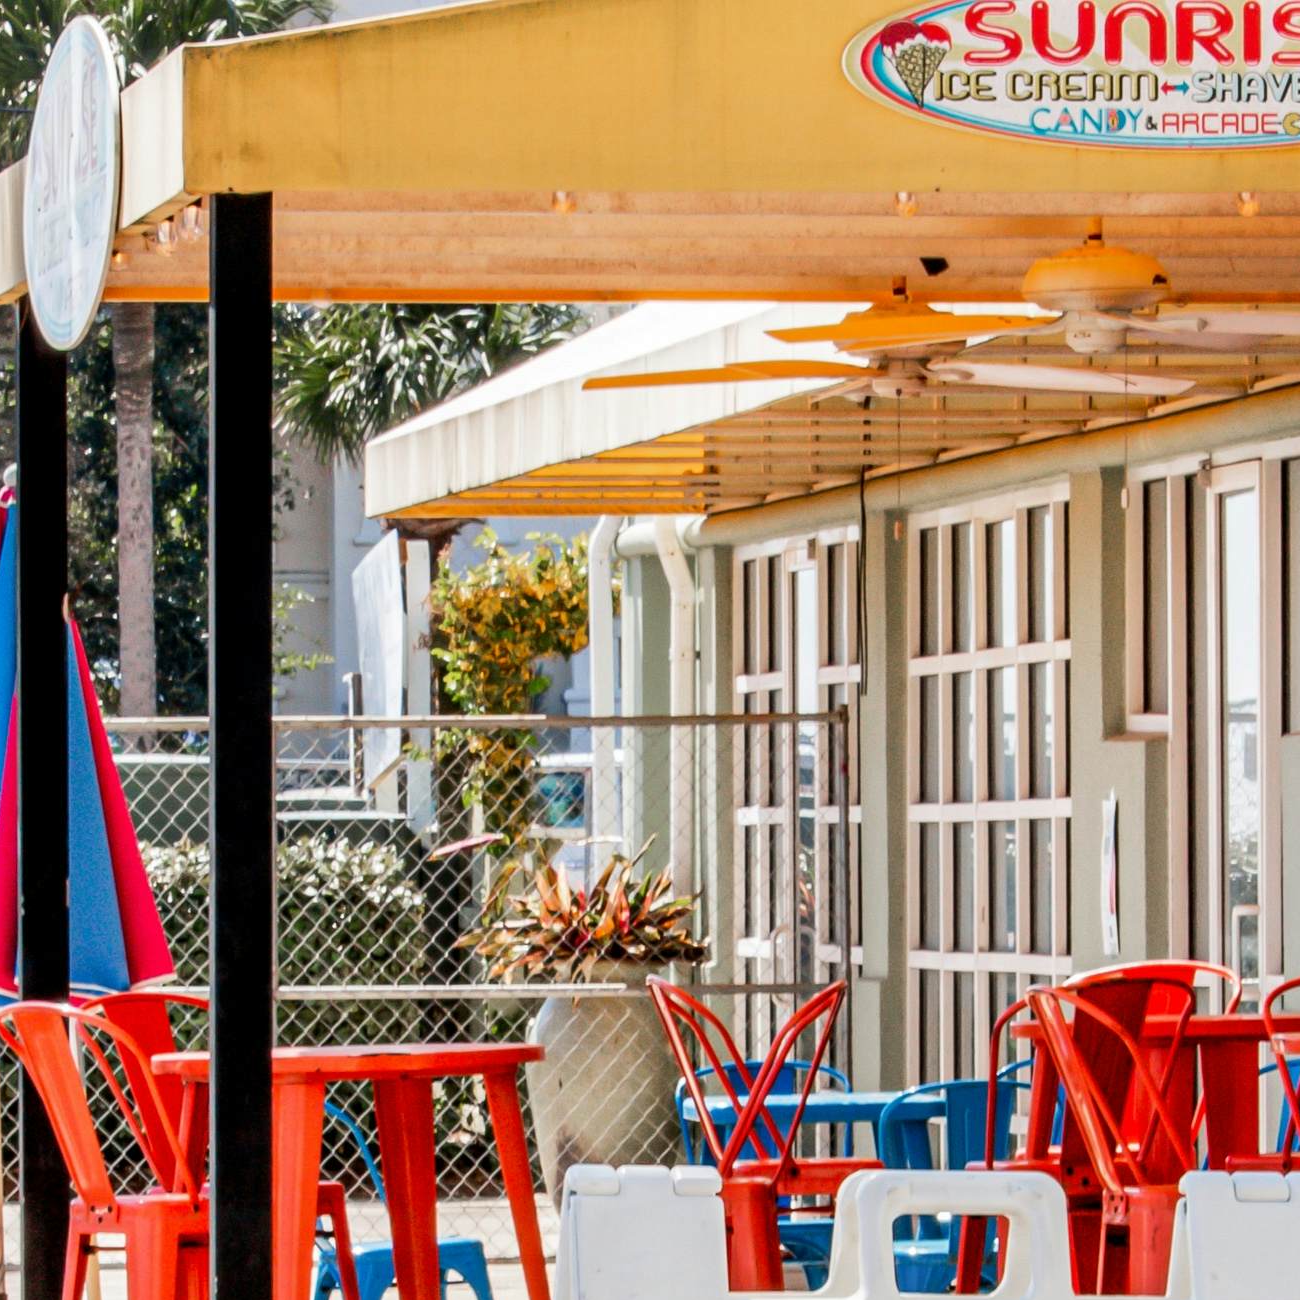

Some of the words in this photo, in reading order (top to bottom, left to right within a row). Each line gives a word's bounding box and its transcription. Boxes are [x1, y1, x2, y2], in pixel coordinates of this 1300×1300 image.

[933, 69, 997, 101] ICE
[1005, 69, 1158, 101] CREAM
[1030, 107, 1143, 134] CANDY
[1145, 115, 1158, 130] &
[1162, 112, 1279, 134] ARCADE
